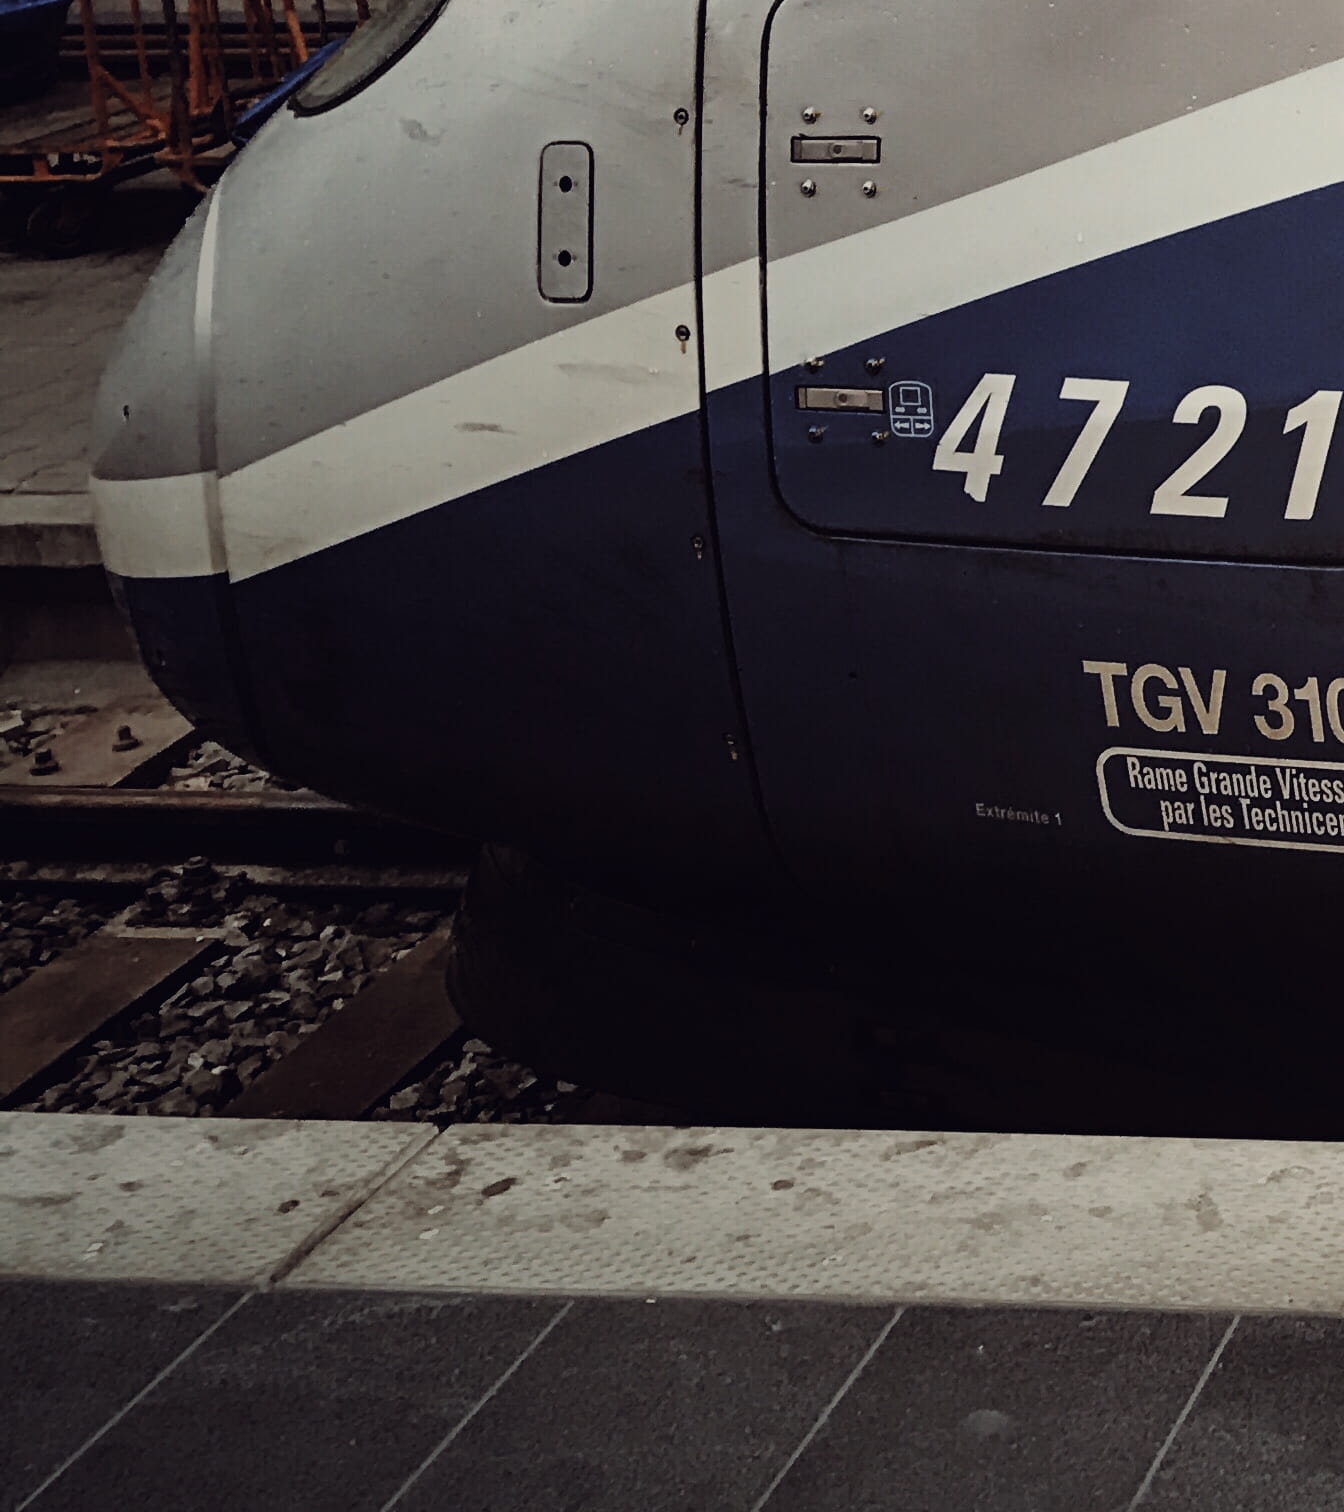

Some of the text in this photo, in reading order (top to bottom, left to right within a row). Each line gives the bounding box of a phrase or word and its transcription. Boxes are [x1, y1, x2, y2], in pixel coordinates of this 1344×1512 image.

[931, 373, 1343, 521] 4721
[1082, 660, 1227, 735] TGV
[1125, 756, 1188, 793] Rame
[1193, 761, 1272, 800] Grande
[1054, 812, 1063, 826] 1
[1159, 799, 1196, 832] par
[1201, 796, 1235, 830] les
